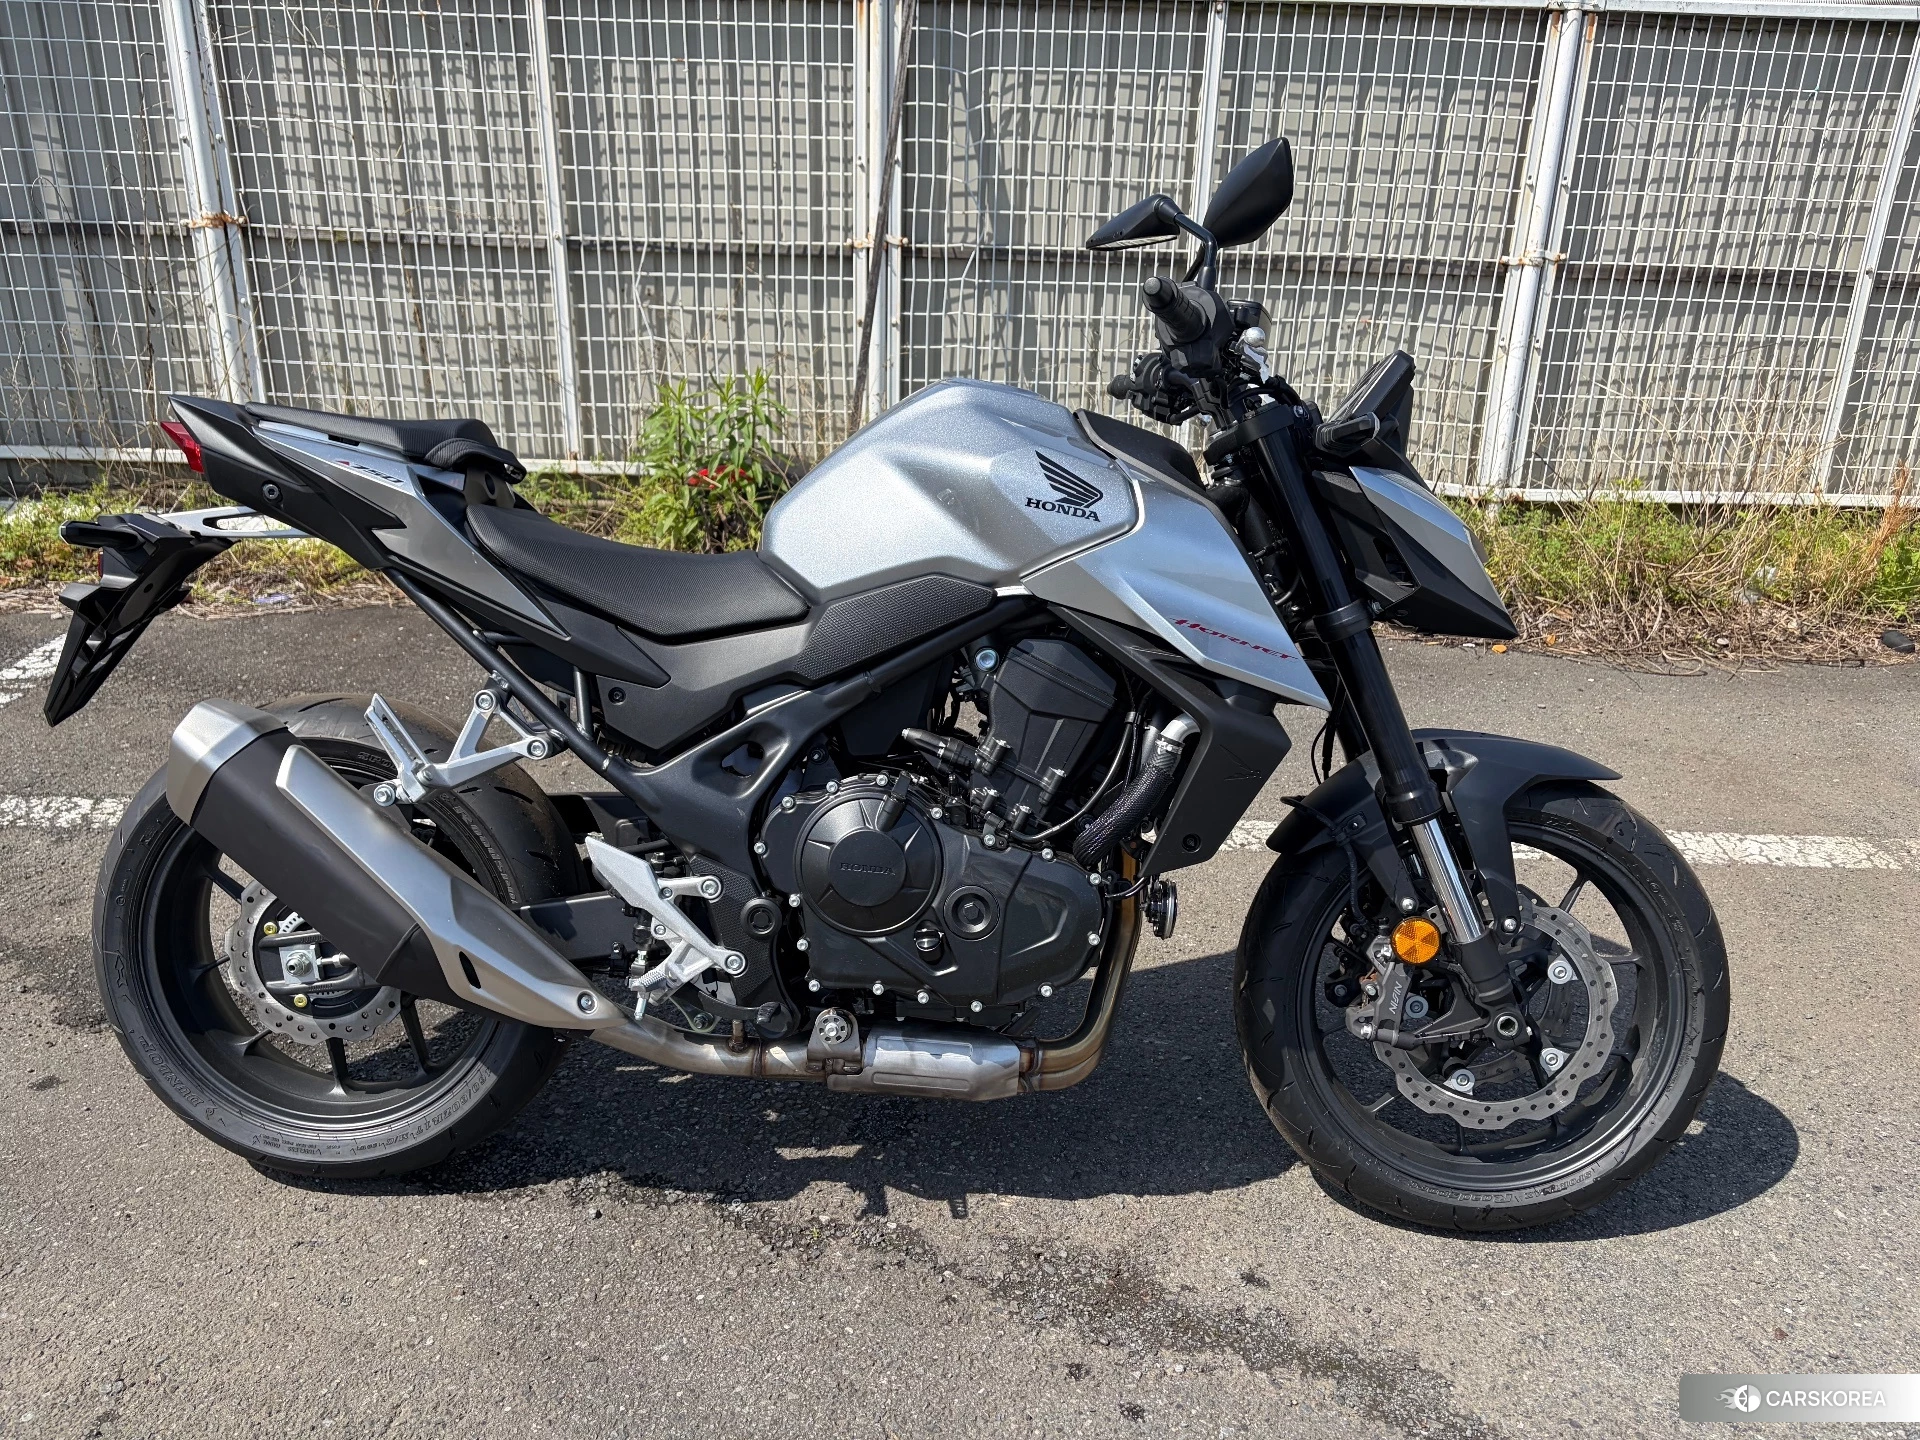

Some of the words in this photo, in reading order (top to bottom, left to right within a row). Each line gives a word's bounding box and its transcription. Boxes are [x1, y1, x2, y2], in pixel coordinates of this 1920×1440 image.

[1025, 497, 1101, 523] HONDA
[839, 862, 897, 876] HONDA
[138, 1035, 205, 1108] DUNLOP
